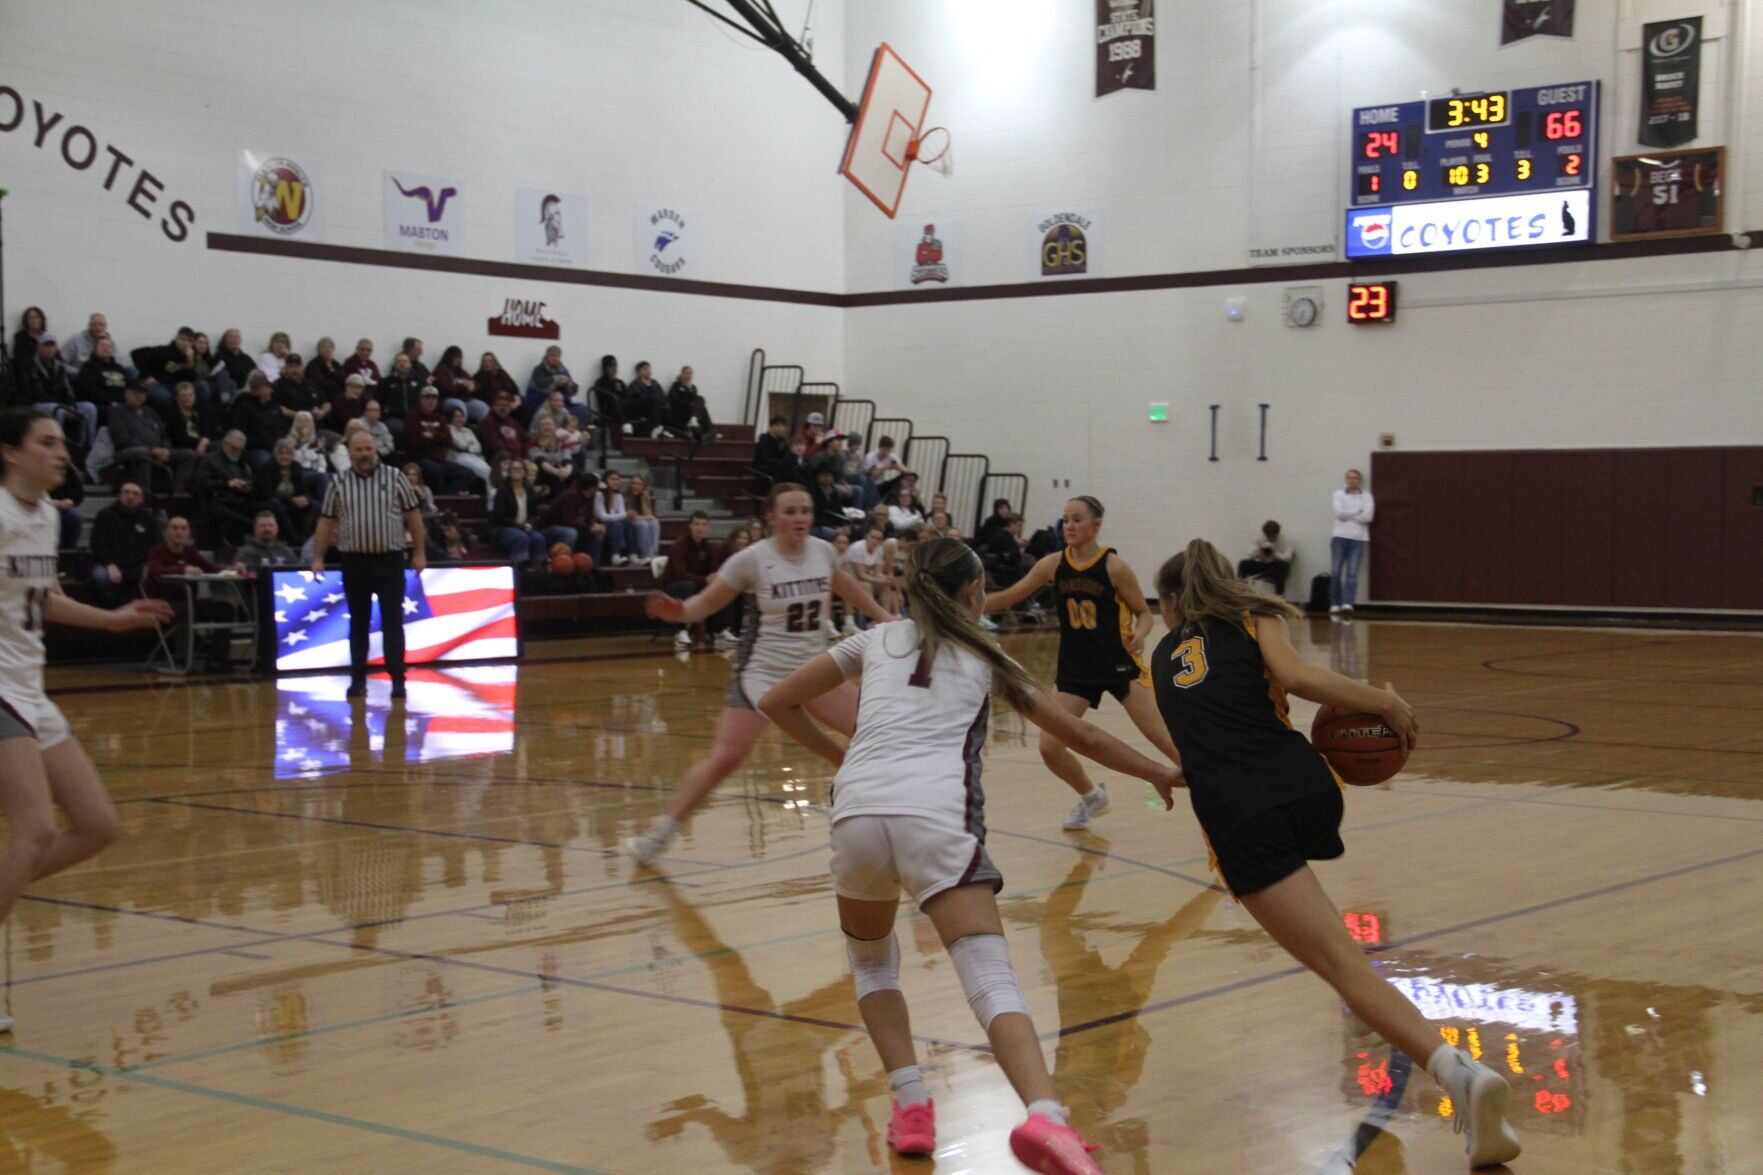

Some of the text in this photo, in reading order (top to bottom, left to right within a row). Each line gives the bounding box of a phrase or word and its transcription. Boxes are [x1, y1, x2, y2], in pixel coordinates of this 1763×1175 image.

[1537, 86, 1586, 105] GUEST
[1359, 107, 1399, 125] HOME
[1447, 94, 1504, 127] 3:43
[1545, 110, 1582, 139] 66
[1365, 131, 1399, 158] 24
[1474, 132, 1488, 148] 4
[1448, 163, 1489, 185] 10 3
[1517, 159, 1530, 180] 3
[1565, 154, 1580, 174] 2
[1370, 174, 1380, 191] 1
[1403, 170, 1417, 190] 0
[1652, 184, 1679, 206] 51
[399, 225, 449, 241] MABTON
[1400, 213, 1550, 249] COYOTES
[1044, 240, 1085, 269] GHS
[1250, 245, 1335, 258] TEAM SPONSORS
[1348, 285, 1388, 319] 23
[786, 600, 821, 633] 22
[1170, 635, 1209, 689] 3
